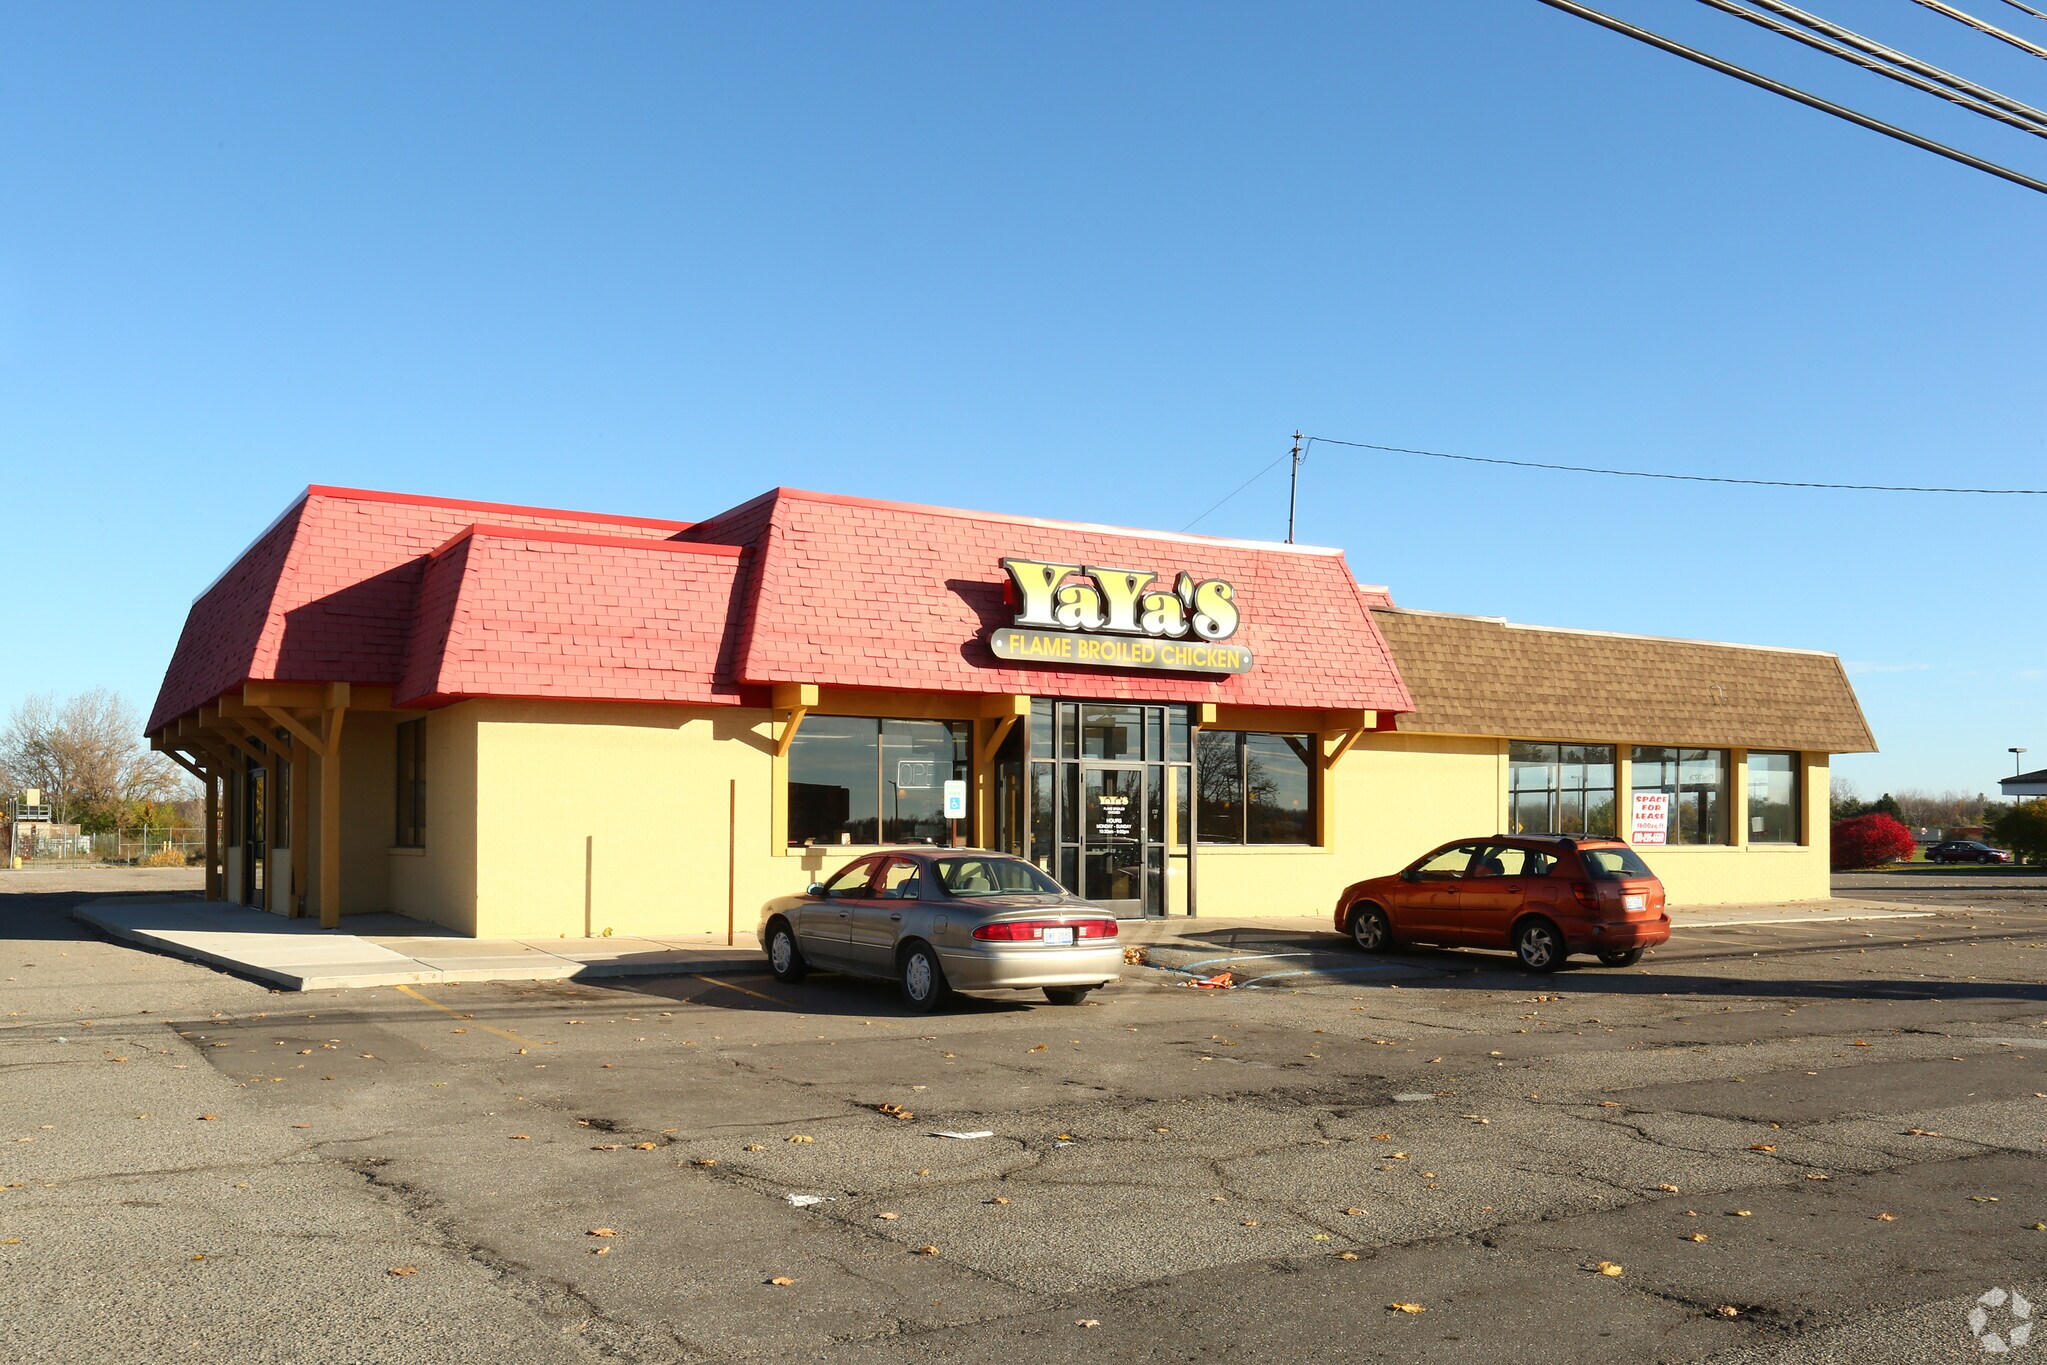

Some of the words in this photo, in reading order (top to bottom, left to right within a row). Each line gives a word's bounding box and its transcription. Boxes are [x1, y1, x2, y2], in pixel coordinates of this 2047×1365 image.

[1009, 634, 1072, 658] FLAME
[1078, 640, 1155, 664] BROILED
[1160, 644, 1240, 669] CHICKEN
